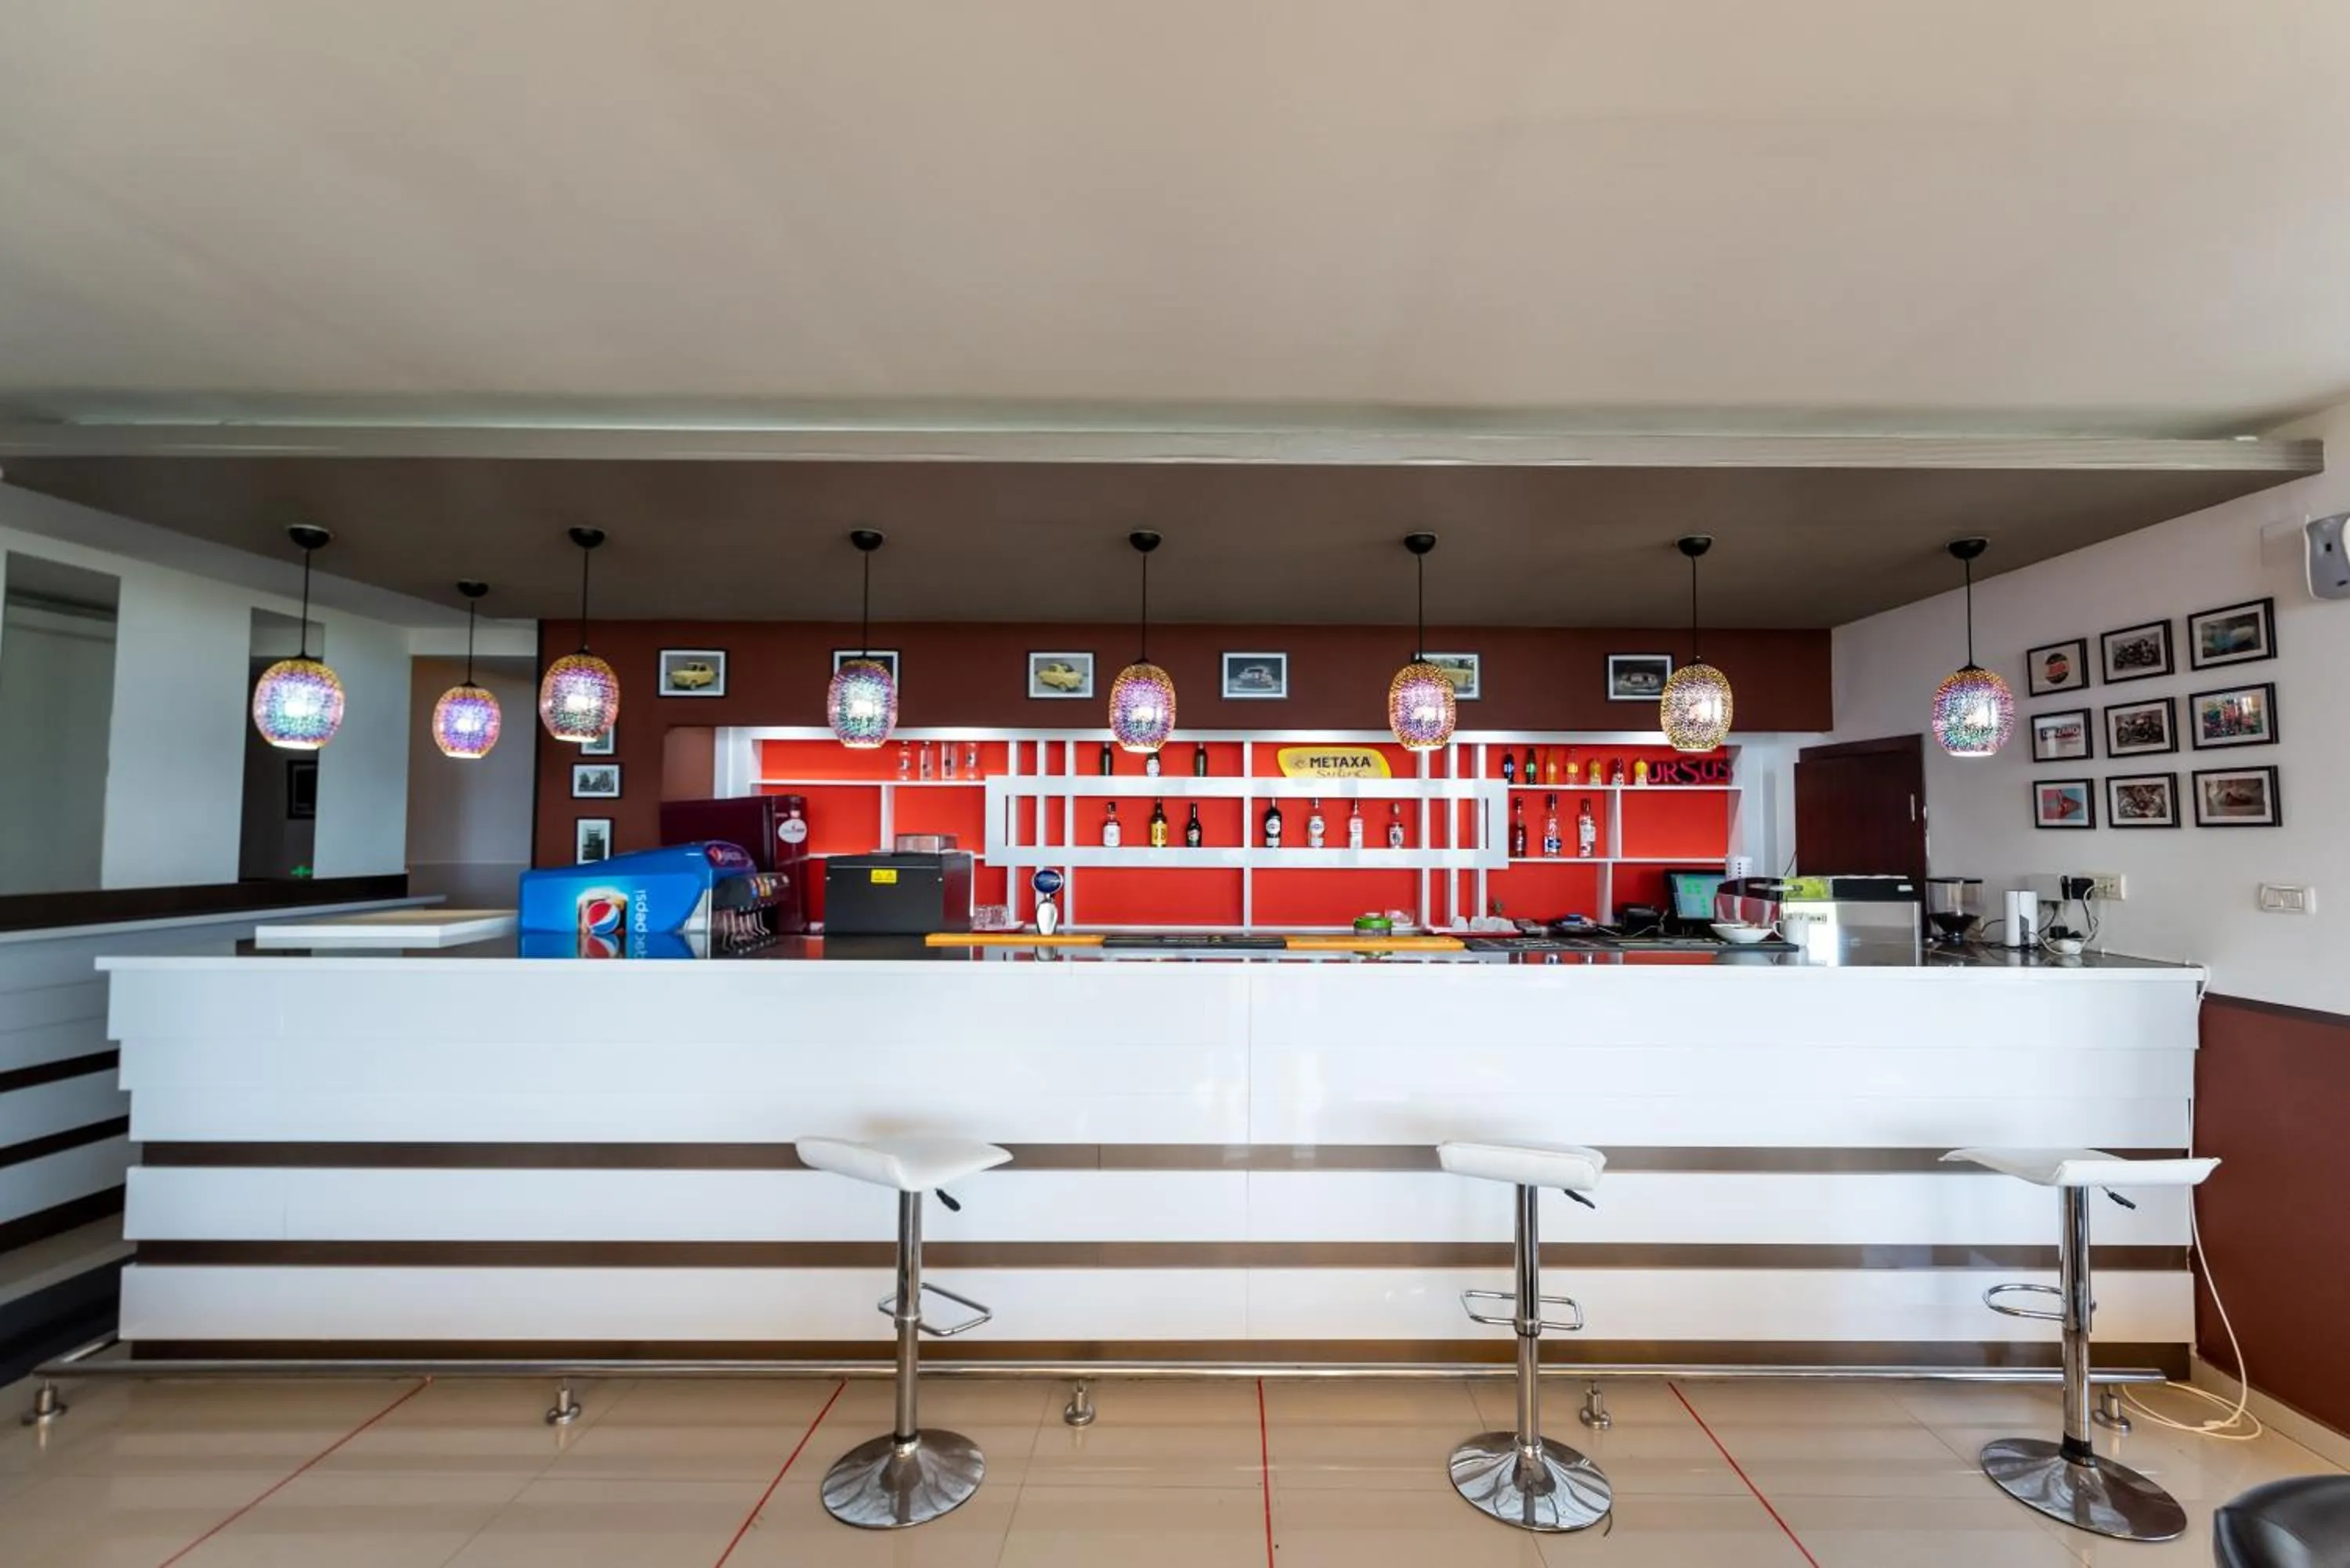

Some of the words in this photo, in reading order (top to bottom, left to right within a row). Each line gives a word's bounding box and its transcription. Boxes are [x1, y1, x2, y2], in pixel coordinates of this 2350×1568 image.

[1309, 756, 1371, 768] METAXA
[1647, 757, 1733, 785] URSUS
[634, 889, 649, 933] pepsi
